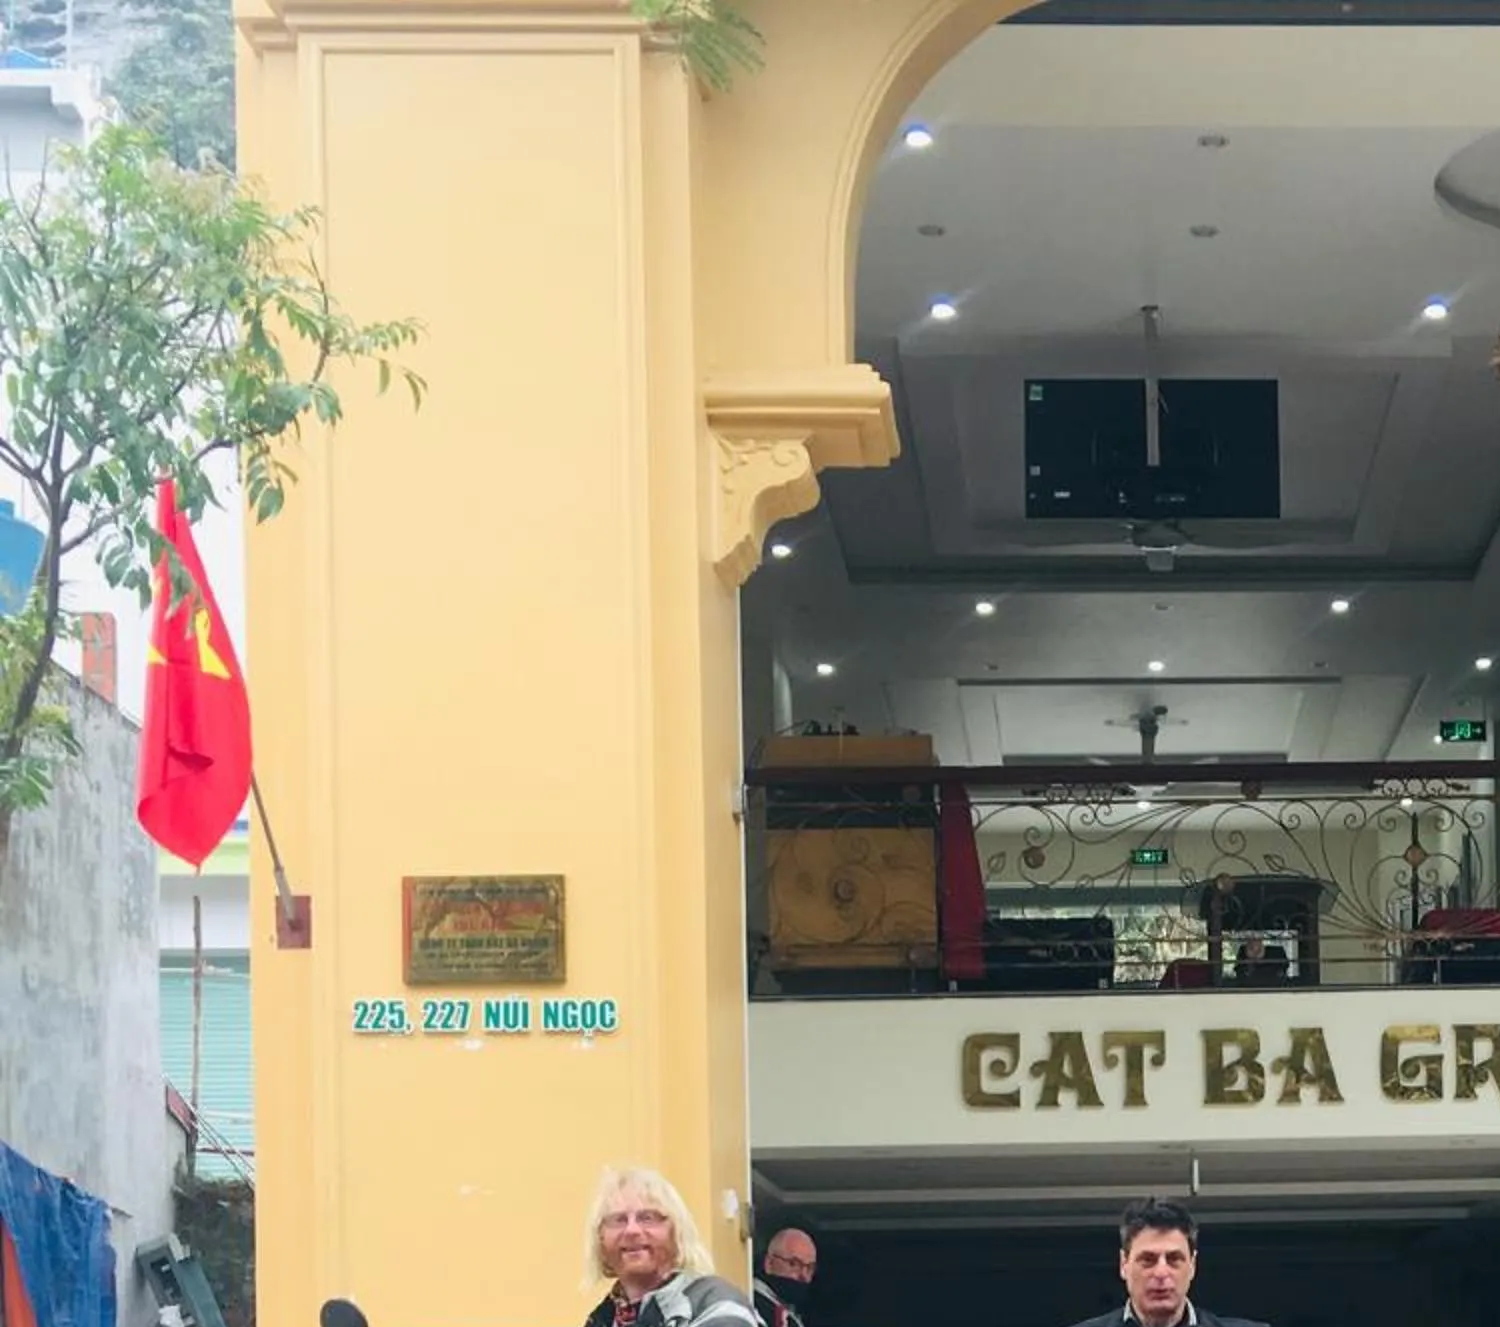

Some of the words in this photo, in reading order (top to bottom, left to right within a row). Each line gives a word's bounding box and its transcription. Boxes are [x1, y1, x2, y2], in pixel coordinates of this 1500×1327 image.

[353, 1000, 411, 1031] 225,
[423, 1000, 470, 1029] 227
[960, 1030, 1167, 1110] CAT
[1201, 1026, 1345, 1108] BA
